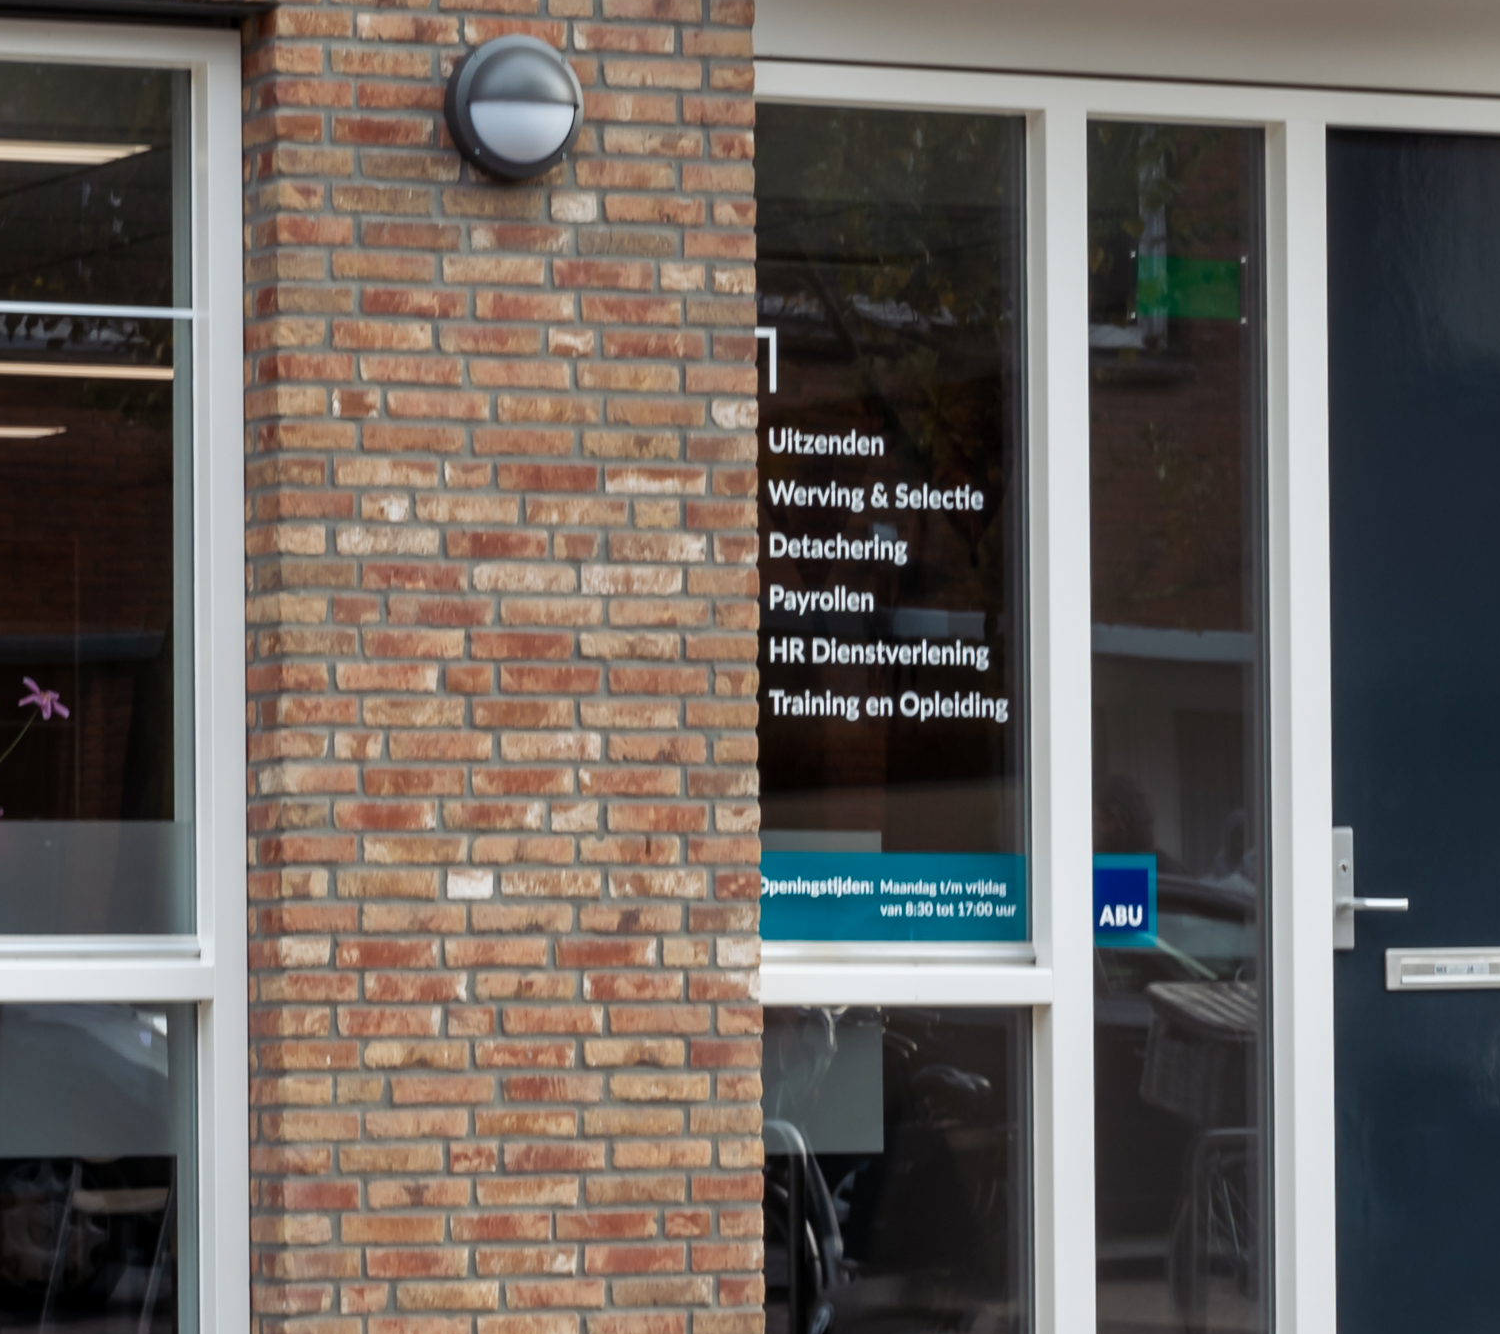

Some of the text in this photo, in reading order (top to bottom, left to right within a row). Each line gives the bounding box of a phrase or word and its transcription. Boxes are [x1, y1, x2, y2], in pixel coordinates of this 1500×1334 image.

[768, 426, 884, 457] Uitzenden
[768, 479, 984, 512] Werving & Selectie
[768, 532, 908, 566] Detachering
[768, 584, 874, 616] Payrollen
[769, 637, 990, 671] HR Dienstverlening
[768, 689, 1009, 724] Training en Opleiding
[761, 876, 1007, 899] Openingstijden: Maandag t/m vrijdag
[880, 904, 902, 917] van
[936, 902, 954, 918] tot
[958, 901, 993, 918] 17:00
[995, 903, 1017, 918] uur
[1099, 903, 1143, 928] ABU
